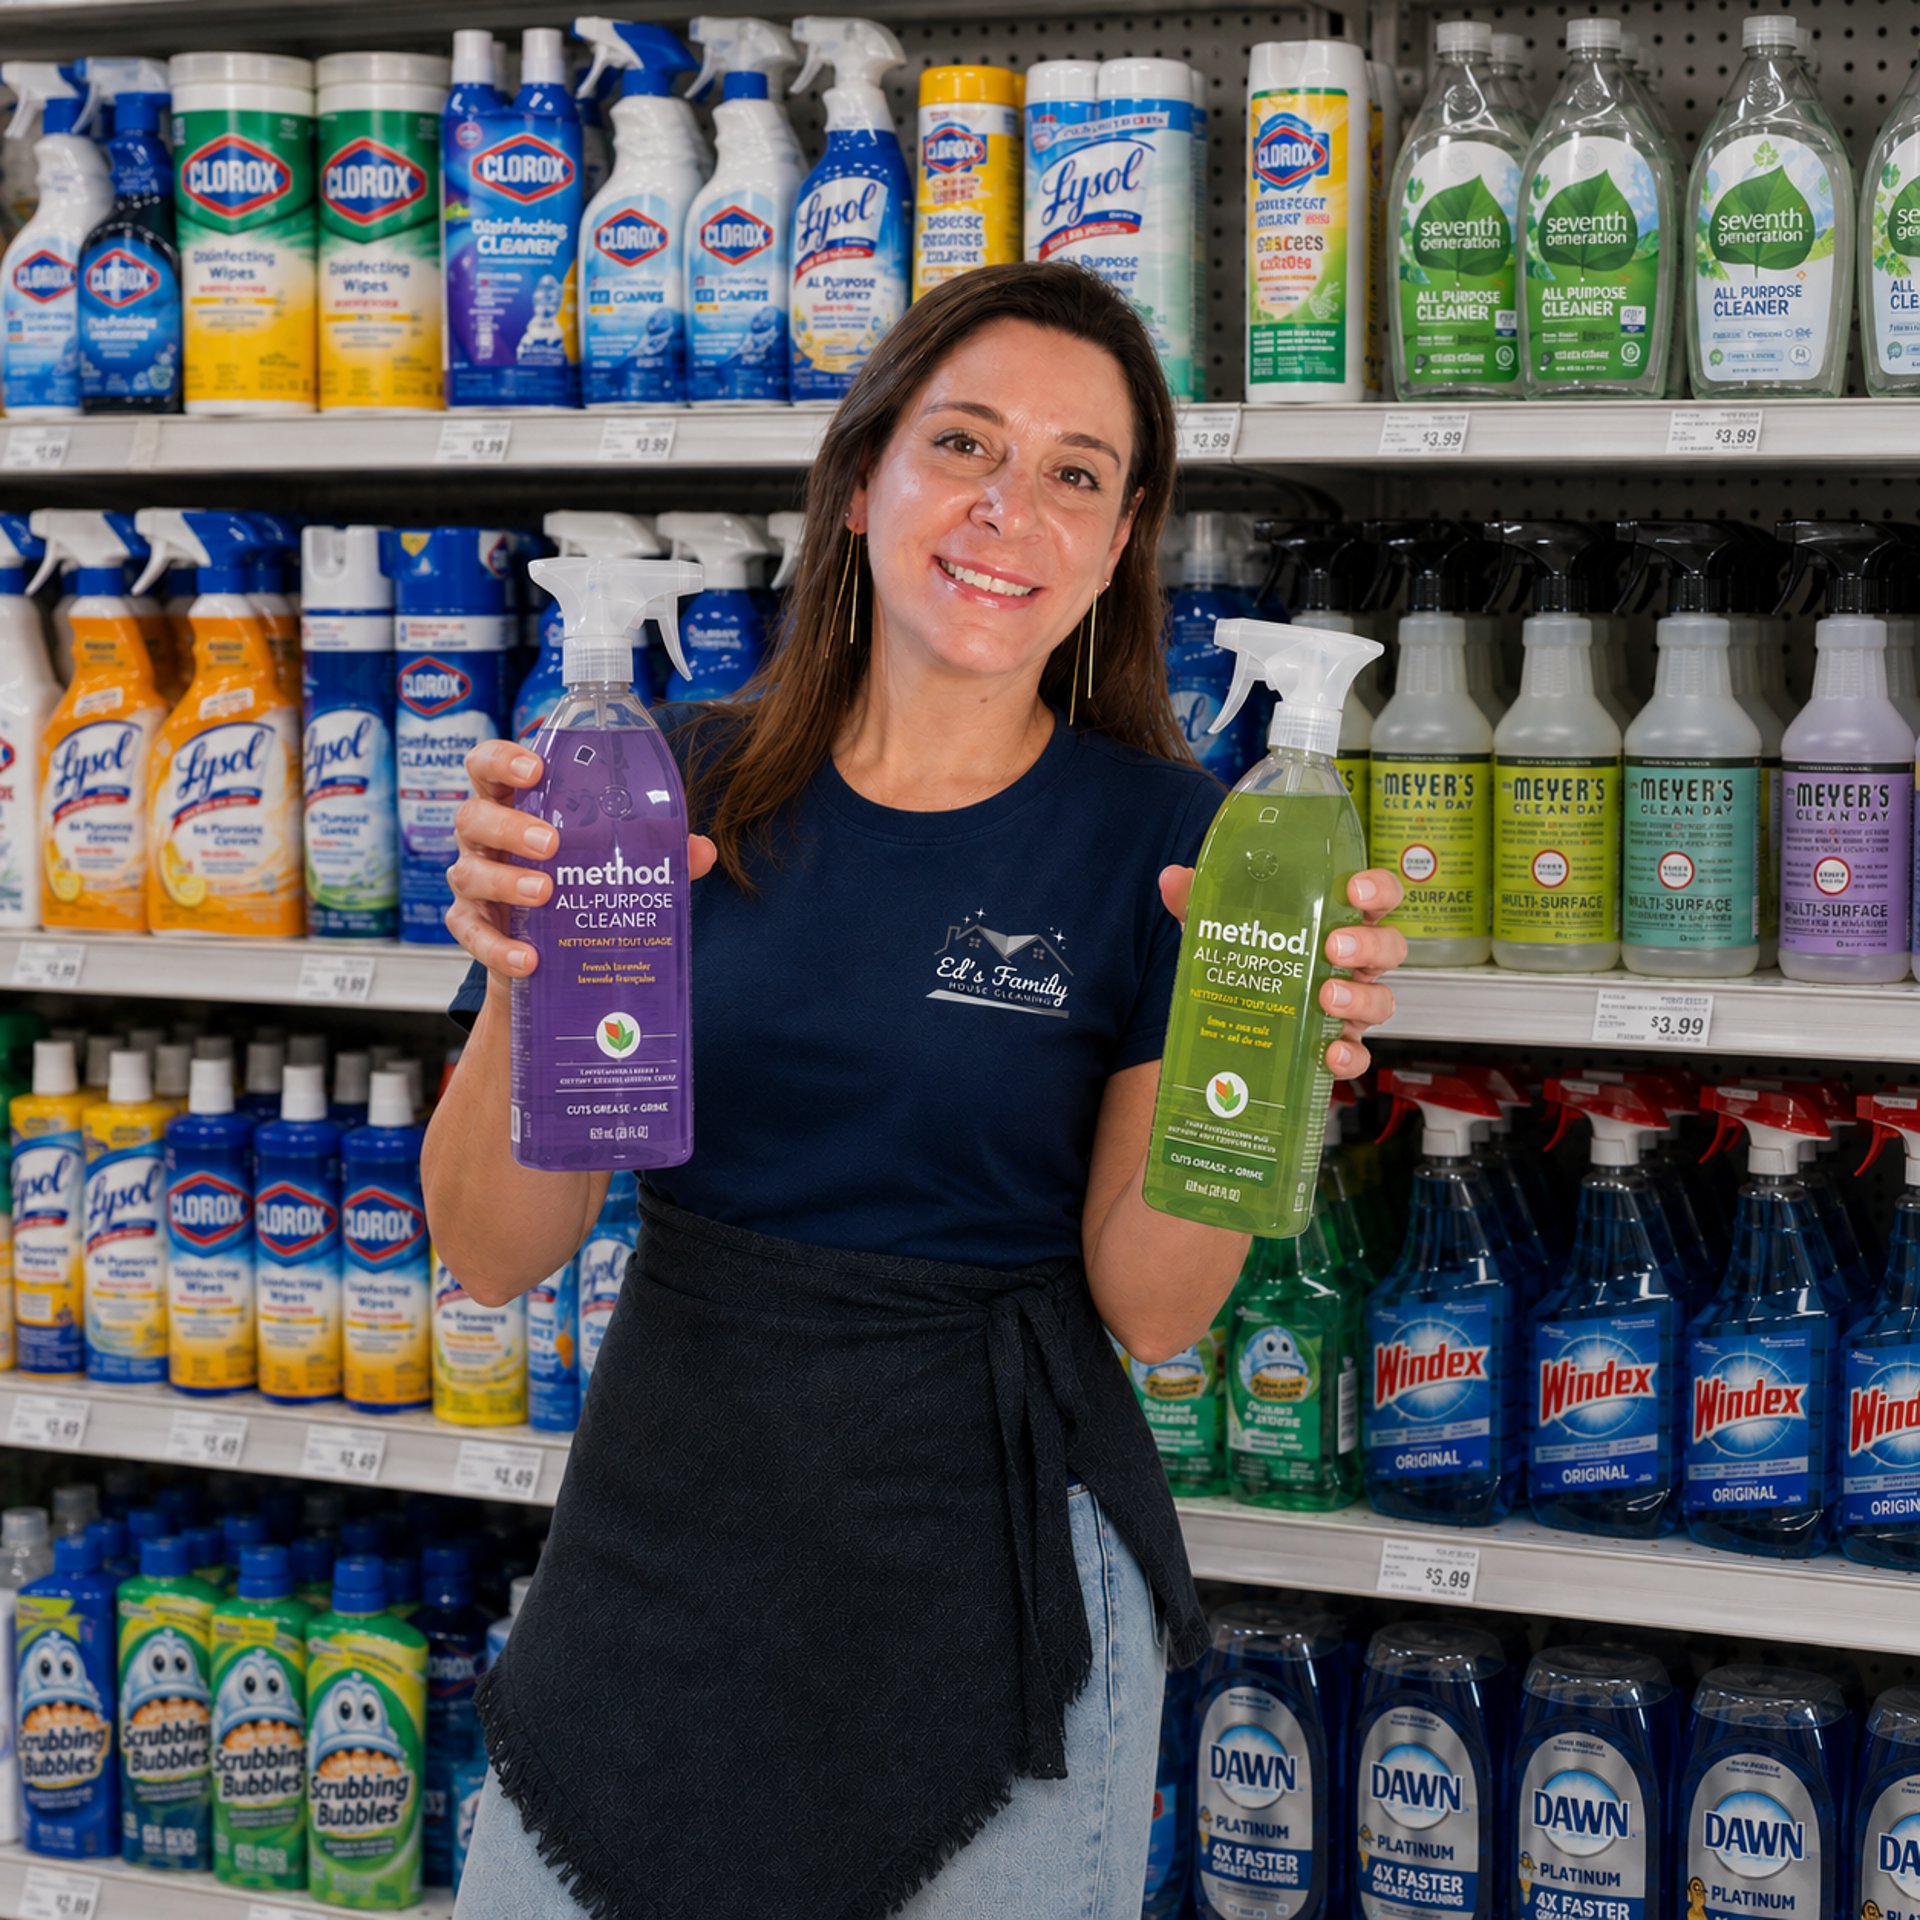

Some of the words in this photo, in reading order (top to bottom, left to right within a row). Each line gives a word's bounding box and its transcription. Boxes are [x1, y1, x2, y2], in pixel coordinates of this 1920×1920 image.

[1258, 143, 1316, 169] CLOROX
[188, 160, 278, 193] CLOROX
[482, 154, 565, 184] CLOROX
[327, 165, 412, 199] CLOROX
[1042, 147, 1144, 227] Lysol
[798, 183, 877, 251] Lysol
[1420, 216, 1500, 237] seventh
[1546, 211, 1627, 233] seventh
[1718, 208, 1803, 231] seventh
[600, 226, 660, 250] CLOROX
[705, 224, 765, 248] CLOROX
[209, 265, 256, 281] Wipes
[343, 277, 388, 294] Wipes
[1417, 291, 1439, 304] ALL
[1542, 287, 1565, 301] ALL
[1714, 287, 1737, 300] ALL
[1741, 285, 1803, 299] PURPOSE
[1891, 280, 1915, 293] ALL
[1417, 304, 1489, 321] CLEANER
[1542, 301, 1613, 317] CLEANER
[1713, 299, 1789, 317] CLEANER
[1192, 433, 1231, 449] $3.99
[1422, 431, 1463, 447] $3.99
[1714, 428, 1757, 445] $3.99
[53, 730, 133, 799] Lysol
[176, 730, 265, 799] Lysol
[1384, 773, 1474, 796] MEYER'S
[1514, 778, 1604, 802] MEYER'S
[1640, 778, 1733, 802] MEYER'S
[1797, 783, 1889, 808] MEYER'S
[1383, 799, 1437, 810] CLEAN
[1446, 800, 1474, 810] DAY
[1513, 804, 1569, 815] CLEAN
[1578, 805, 1604, 815] DAY
[1641, 805, 1694, 816] CLEAN
[1703, 805, 1733, 816] DAY
[1796, 810, 1849, 821] CLEAN
[1858, 811, 1889, 822] DAY
[556, 893, 673, 910] ALL-PURPOSE
[575, 912, 657, 928] CLEANER
[1193, 946, 1304, 979] ALL-PURPOSE
[936, 956, 985, 982] Ed's
[991, 965, 1069, 1007] Family
[948, 981, 988, 994] HOUSE
[1206, 968, 1283, 995] CLEANER
[1651, 1015, 1705, 1036] $3.99
[567, 1105, 592, 1115] CUTS
[86, 1163, 161, 1230] Lysol
[172, 1193, 243, 1225] CLOROX
[259, 1203, 326, 1235] CLOROX
[344, 1208, 414, 1240] CLOROX
[1375, 1341, 1489, 1409] Windex
[1540, 1360, 1656, 1426] Windex
[1693, 1378, 1804, 1444] Windex
[1395, 1451, 1461, 1470] ORIGINAL
[1562, 1464, 1629, 1485] ORIGINAL
[1712, 1483, 1777, 1503] ORIGINAL
[24, 1750, 97, 1778] Bubbles
[1211, 1745, 1296, 1791] DAWN
[222, 1772, 302, 1797] Bubbles
[310, 1773, 409, 1802] Scrubbing
[1371, 1763, 1462, 1811] DAWN
[317, 1800, 399, 1827] Bubbles
[1534, 1791, 1629, 1837] DAWN
[1216, 1815, 1289, 1840] PLATINUM
[1705, 1812, 1803, 1860] DAWN
[1212, 1844, 1234, 1862] 4X
[1235, 1848, 1298, 1872] FASTER
[1377, 1835, 1454, 1861] PLATINUM
[1373, 1863, 1394, 1882] 4X
[1397, 1869, 1463, 1894] FASTER
[1540, 1863, 1621, 1887] PLATINUM
[1536, 1891, 1558, 1912] 4X
[1561, 1897, 1630, 1920] FASTER
[1710, 1886, 1796, 1910] PLATINUM
